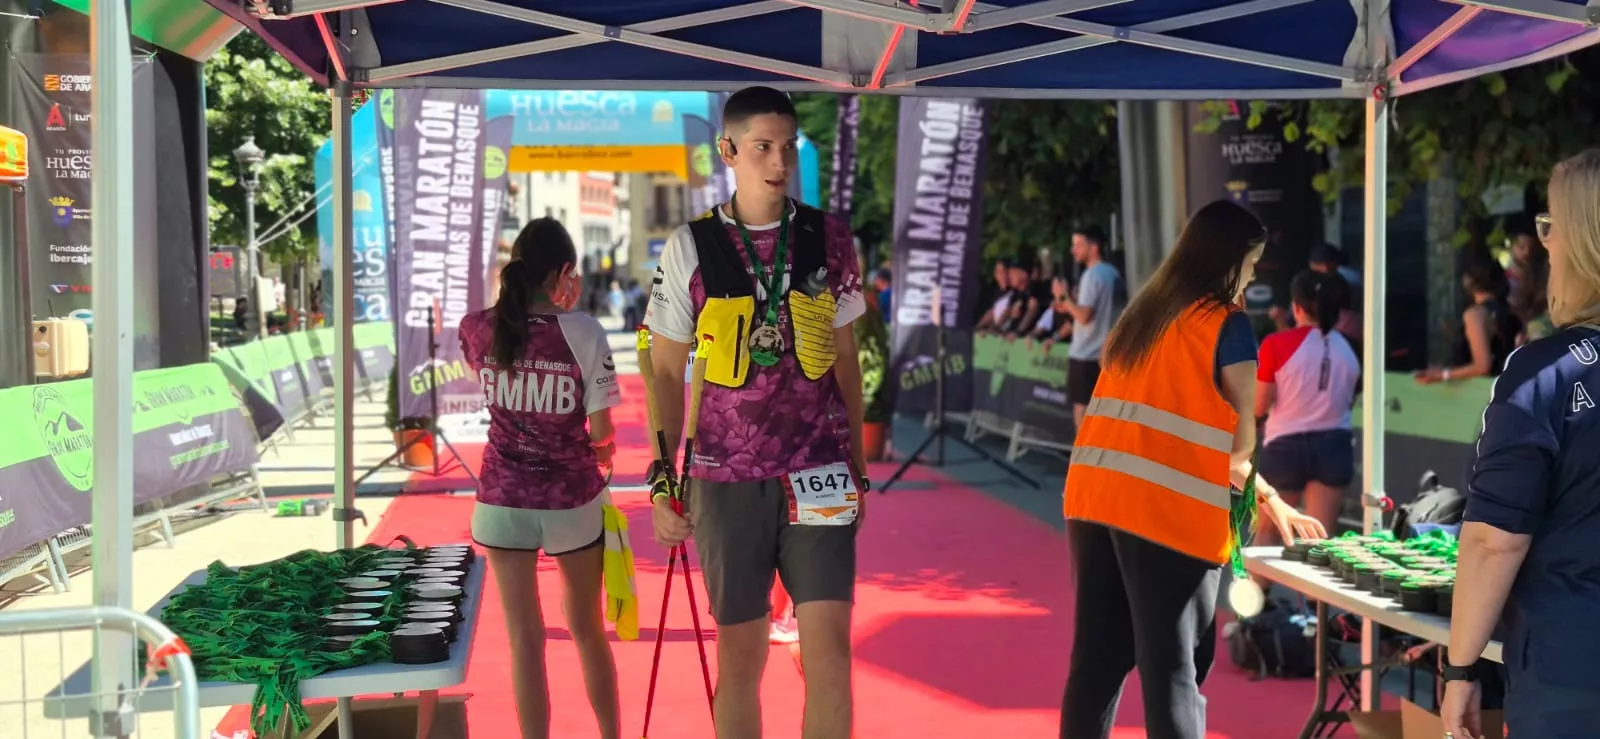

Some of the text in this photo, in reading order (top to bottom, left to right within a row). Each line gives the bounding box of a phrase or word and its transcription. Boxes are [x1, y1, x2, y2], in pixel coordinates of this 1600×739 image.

[908, 101, 961, 240] MARATÓN
[950, 104, 984, 198] BENASQUE
[405, 100, 456, 328] GRAN MARATÓN
[442, 104, 480, 328] MONTAÑAS DE BENASQUE
[948, 202, 970, 226] DE
[524, 360, 533, 369] DE
[535, 360, 572, 372] BENASQUE
[480, 367, 576, 415] GMMB
[1572, 381, 1596, 412] A
[794, 473, 849, 493] 1647
